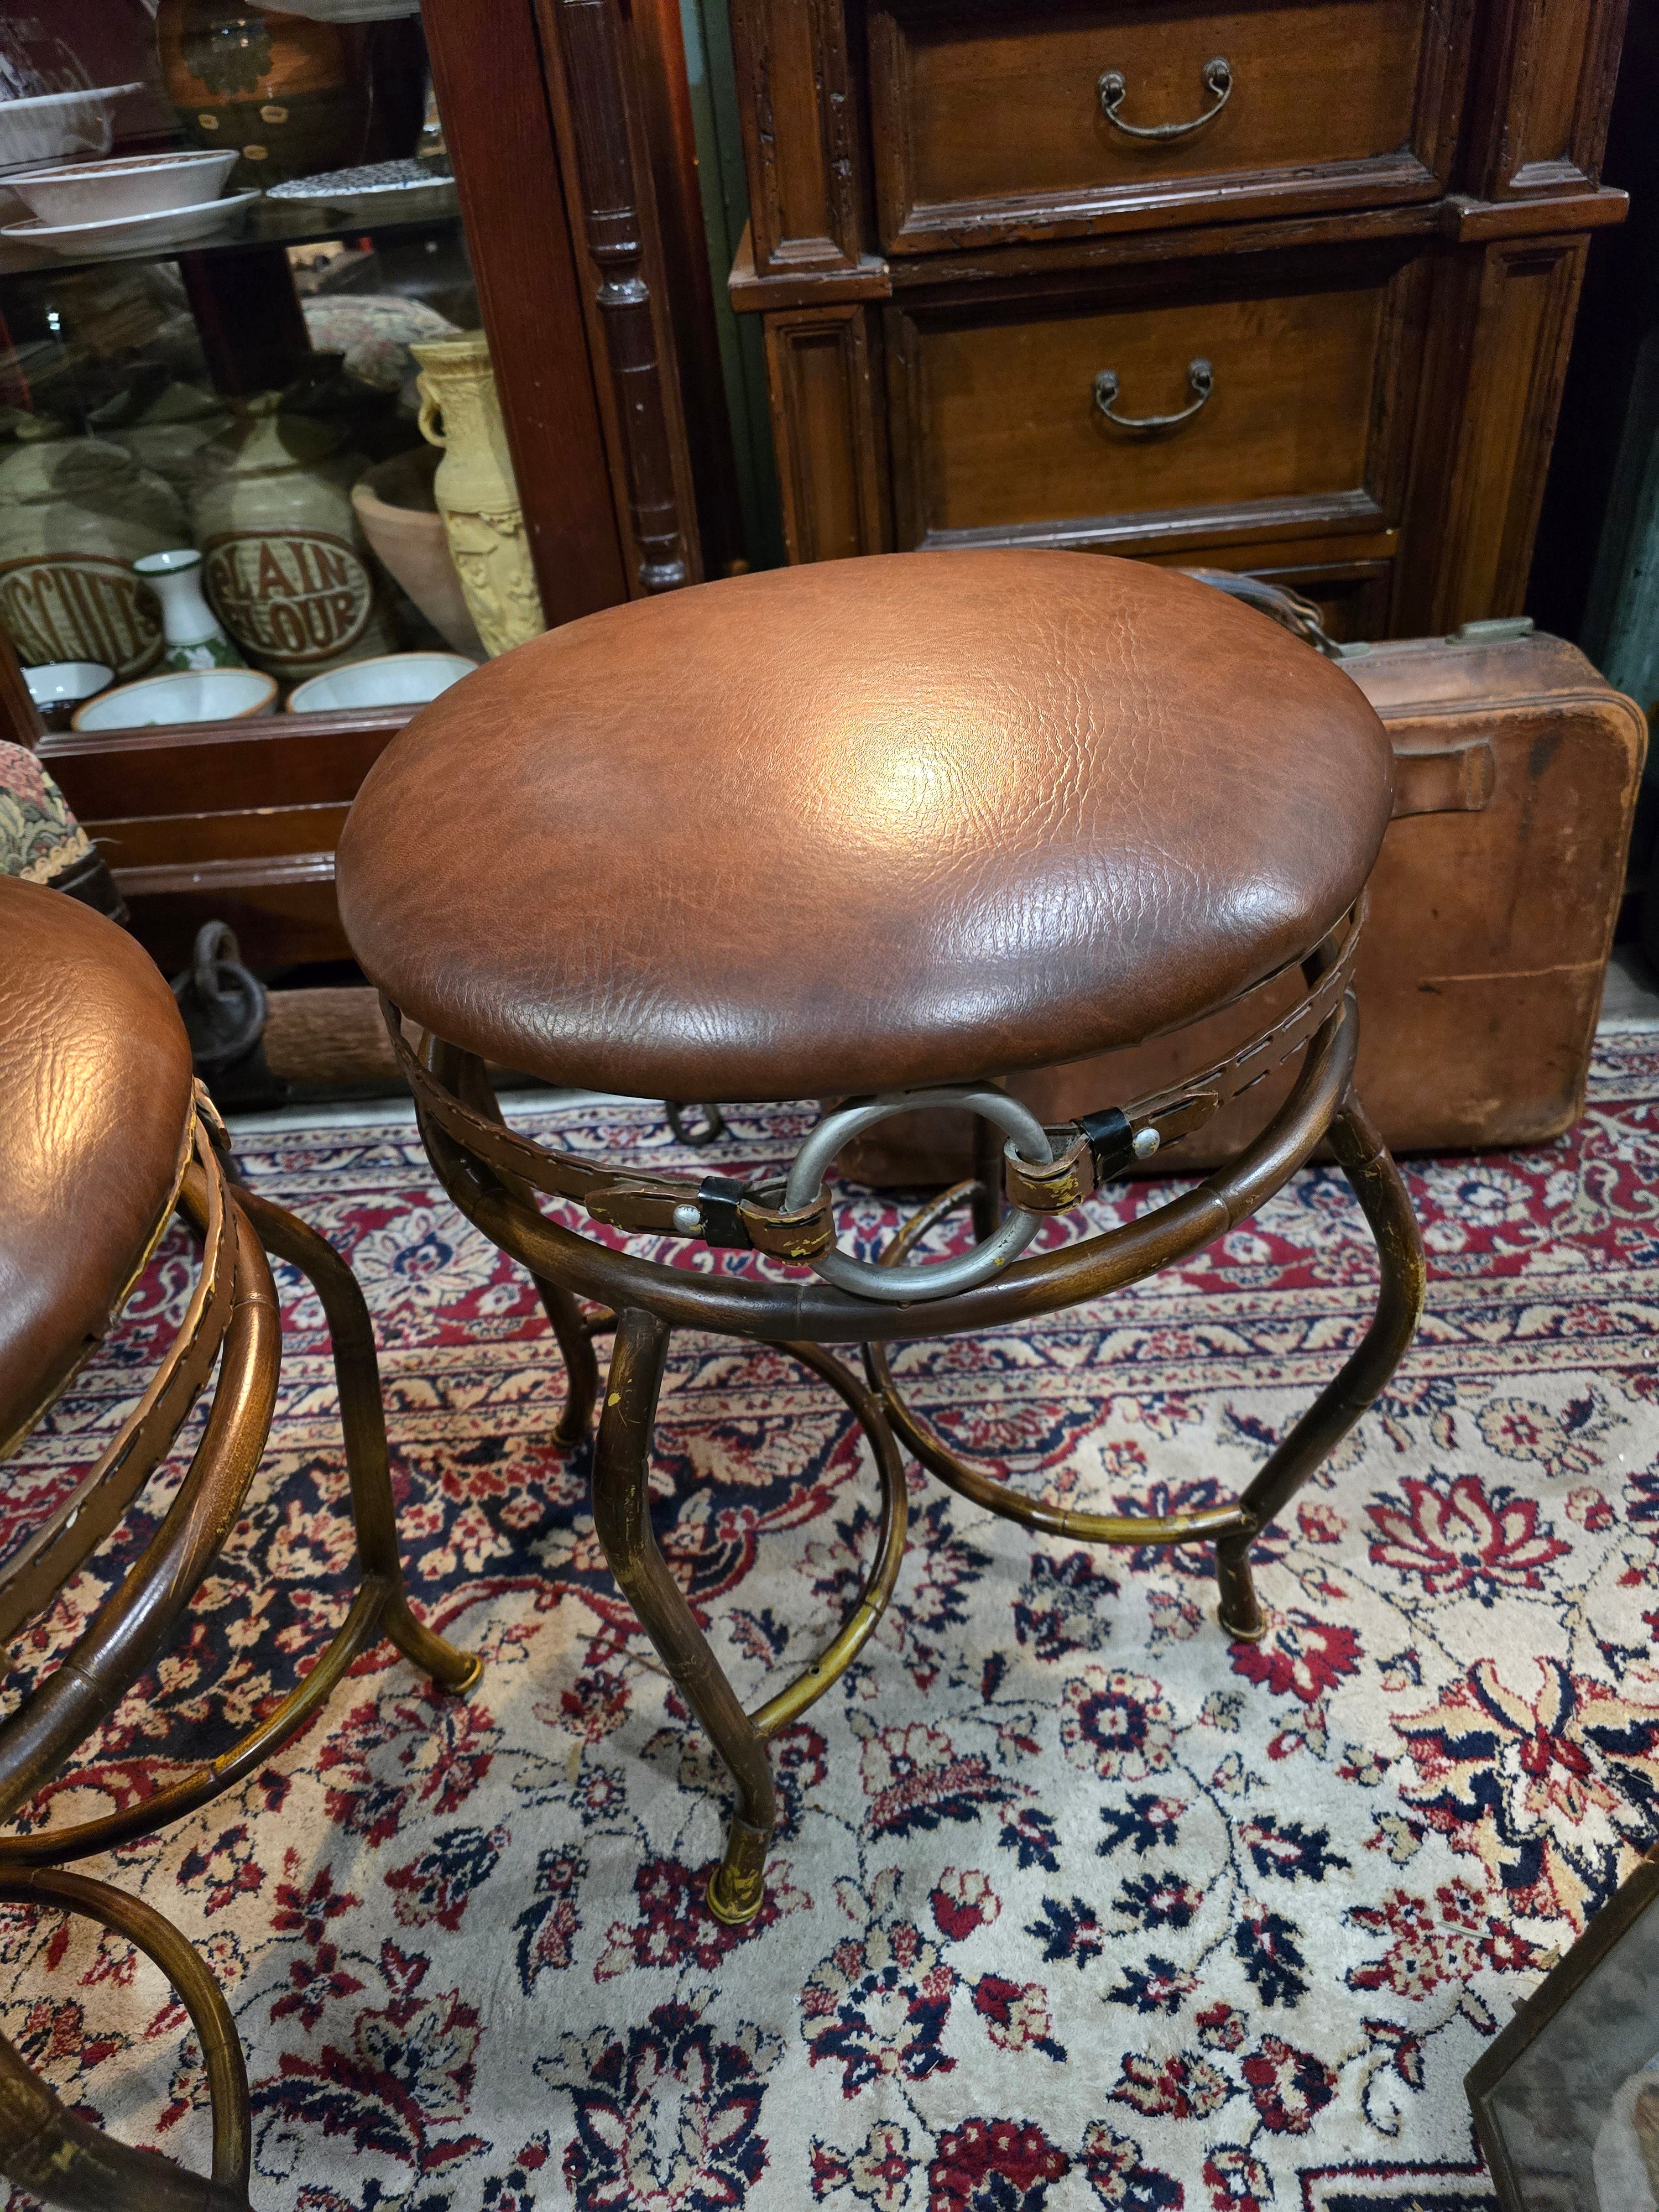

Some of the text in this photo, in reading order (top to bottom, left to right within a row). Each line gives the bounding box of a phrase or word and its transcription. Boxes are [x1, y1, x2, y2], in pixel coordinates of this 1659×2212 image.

[210, 541, 348, 601] PLAIN
[0, 568, 160, 662] ISCUITS
[221, 591, 356, 652] FLOUR
